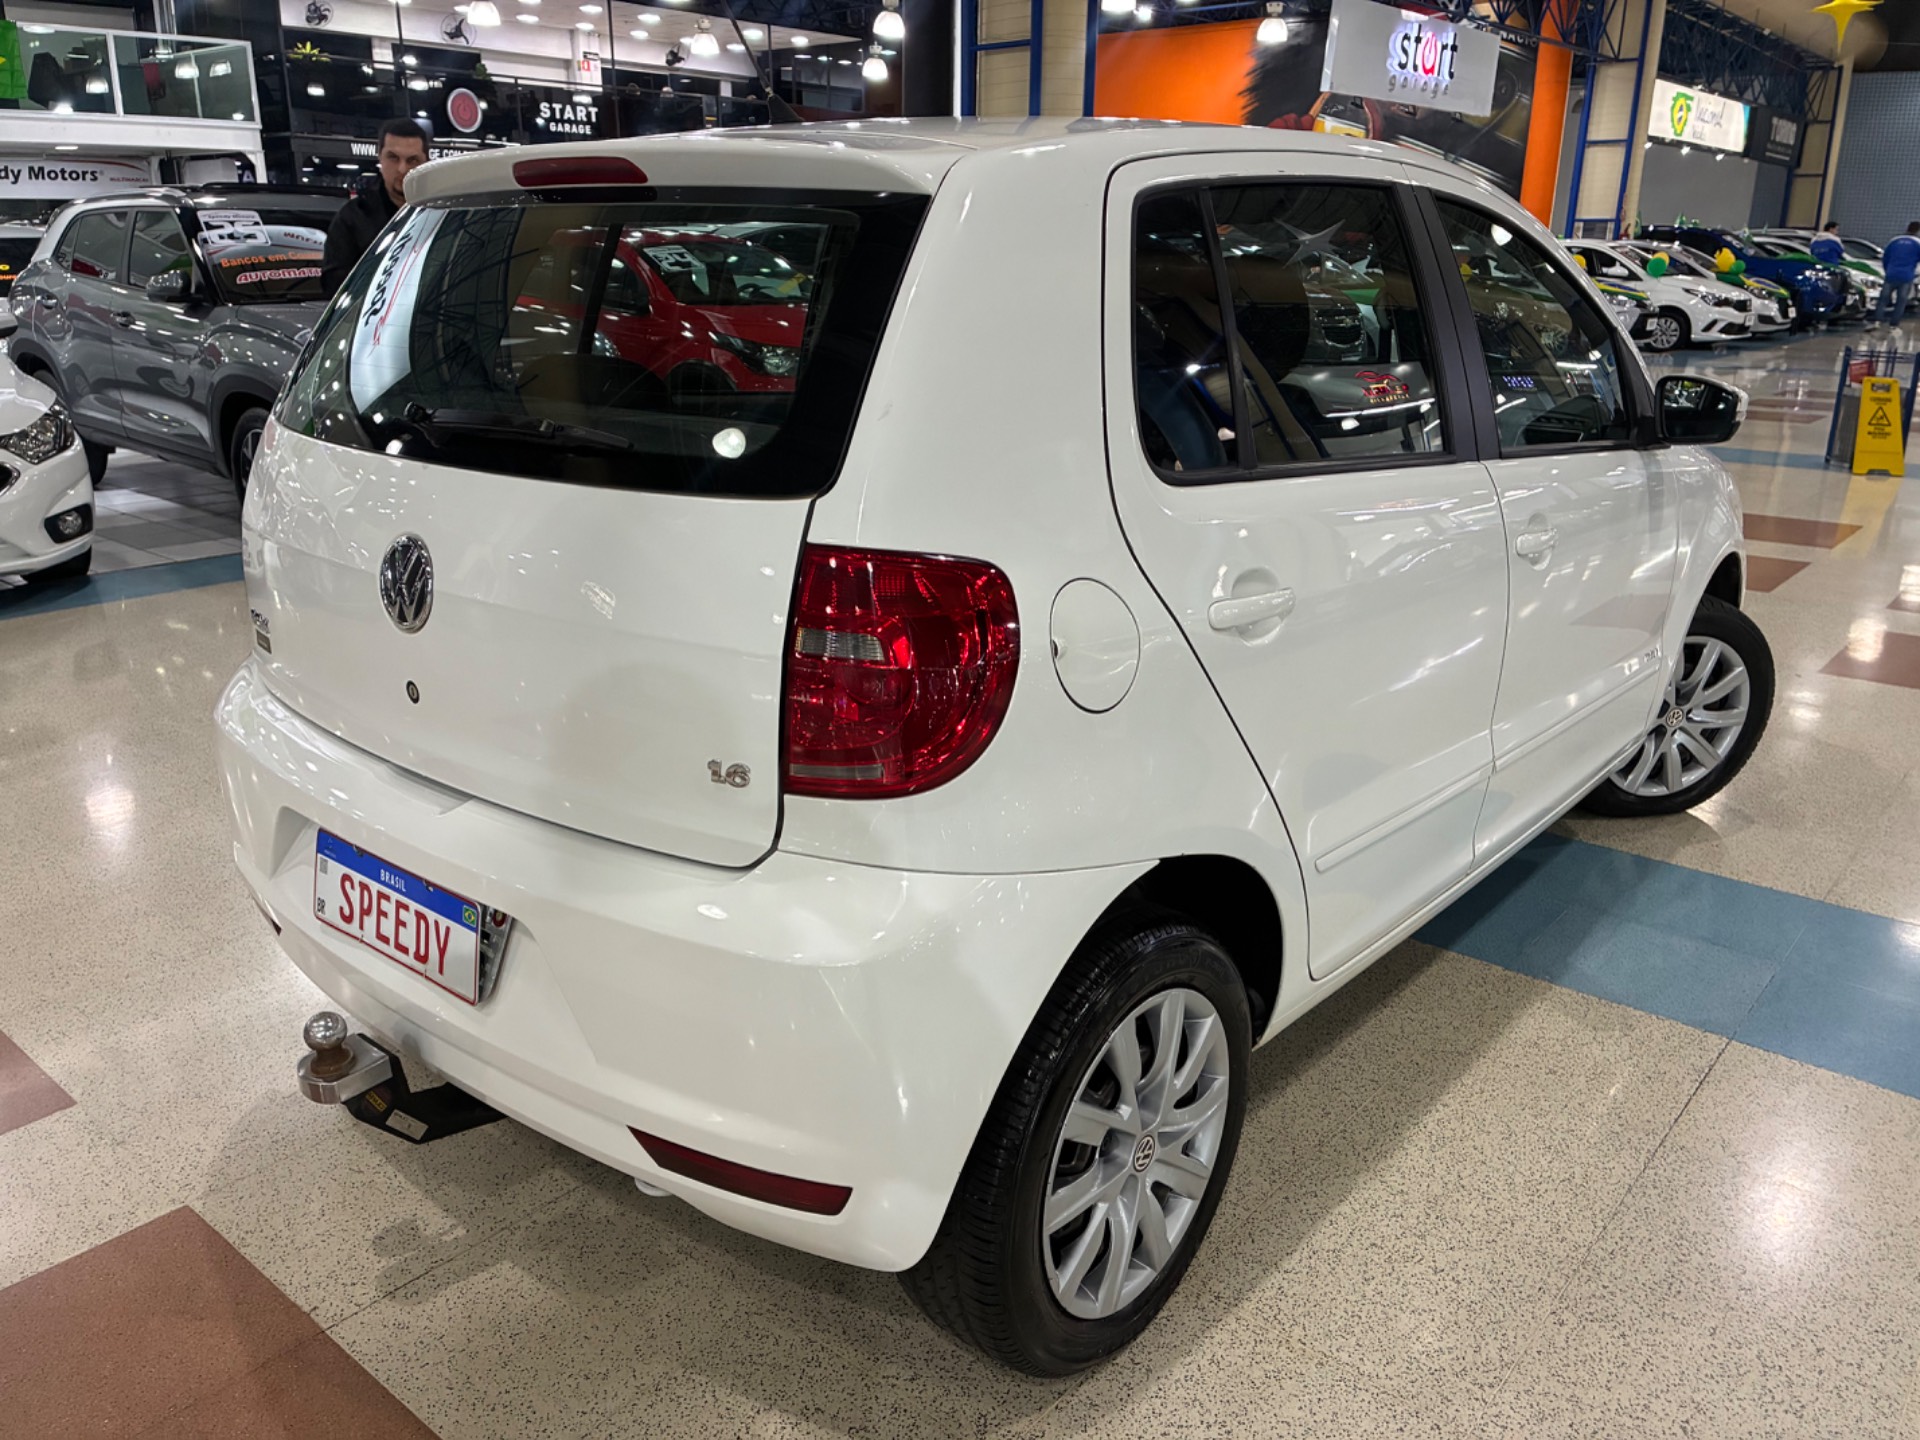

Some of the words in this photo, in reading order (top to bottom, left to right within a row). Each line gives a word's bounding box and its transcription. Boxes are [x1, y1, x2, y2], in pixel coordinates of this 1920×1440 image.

[1398, 23, 1458, 80] start
[539, 101, 598, 123] START
[549, 121, 592, 135] GARAGE
[27, 165, 98, 182] Motors
[220, 256, 265, 268] Bancos
[268, 254, 286, 262] em
[707, 759, 751, 789] 1.6
[379, 868, 407, 893] BRASIL
[316, 896, 326, 915] BR
[339, 872, 451, 977] SPEEDY
